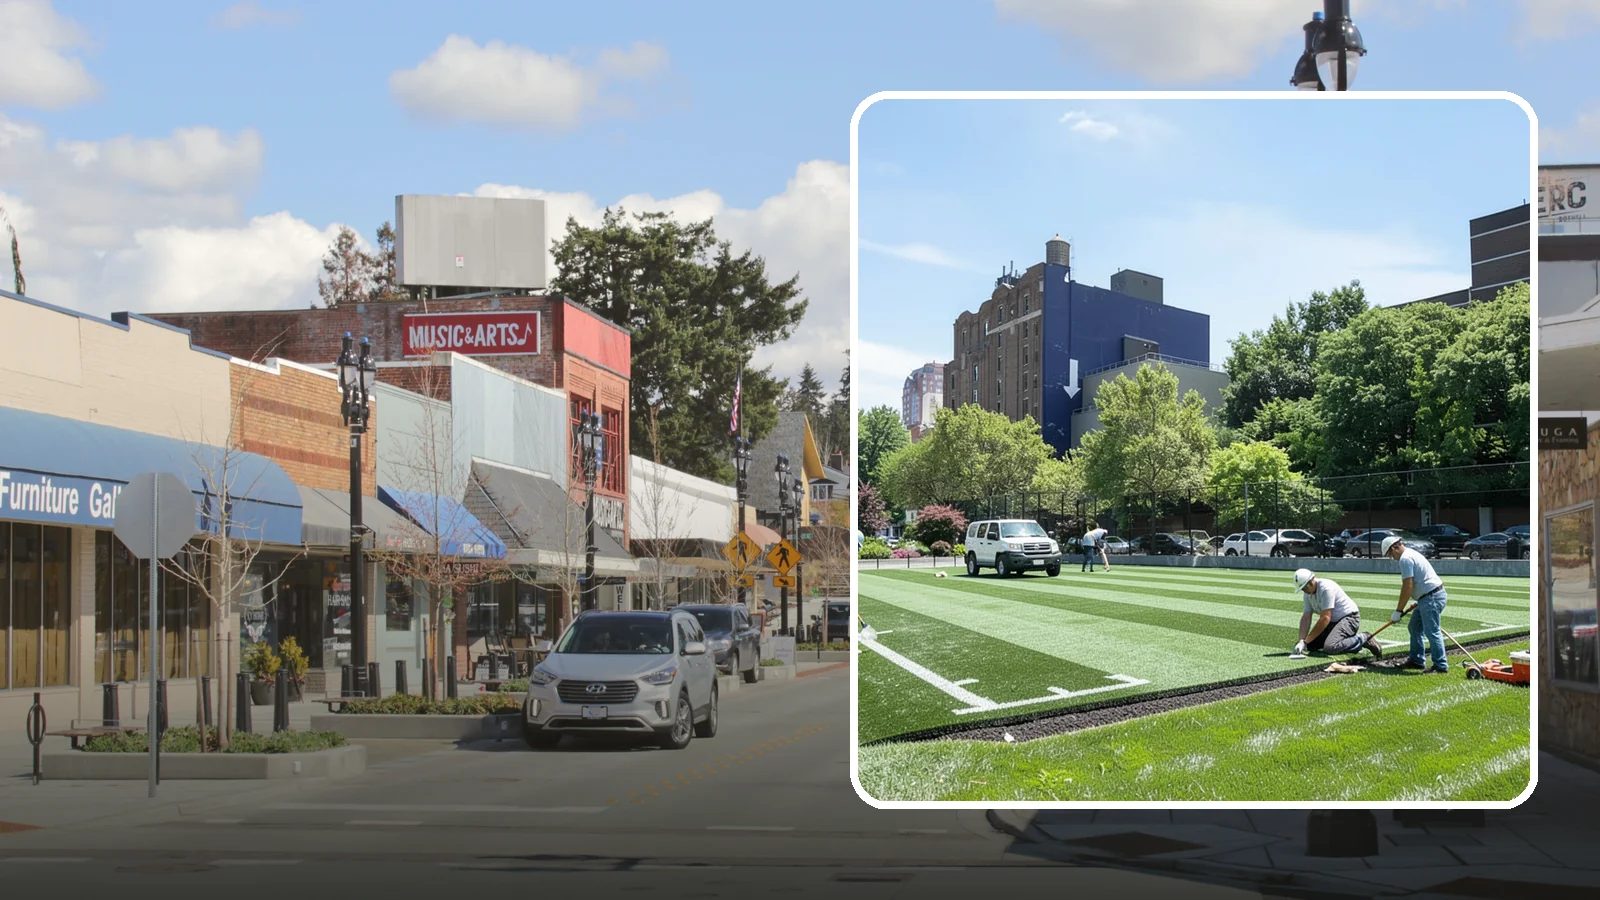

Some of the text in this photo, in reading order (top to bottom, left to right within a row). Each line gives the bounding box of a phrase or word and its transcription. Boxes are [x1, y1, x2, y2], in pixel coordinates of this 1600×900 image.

[0, 471, 121, 519] Furniture Gal
[453, 563, 479, 574] SUSHI
